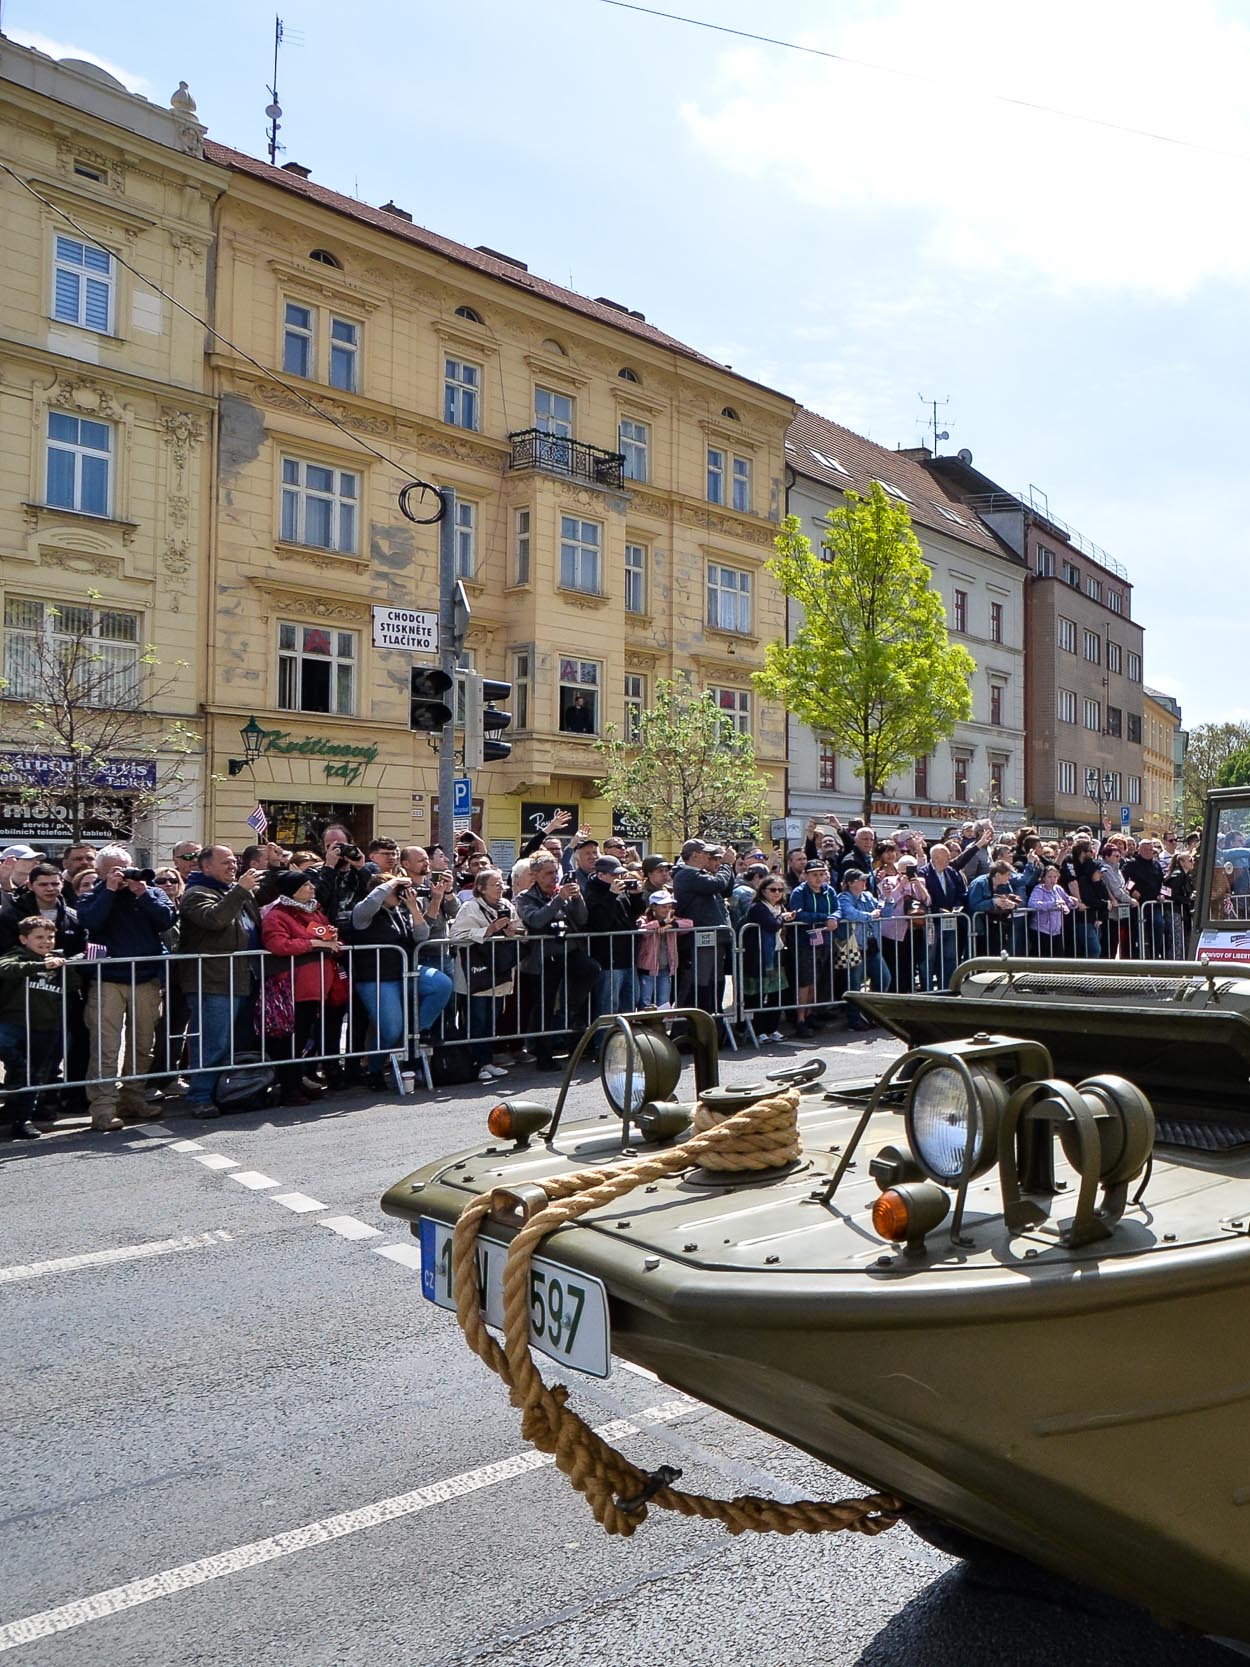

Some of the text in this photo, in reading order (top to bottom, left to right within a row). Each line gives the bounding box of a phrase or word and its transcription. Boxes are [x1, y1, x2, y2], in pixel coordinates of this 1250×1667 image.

[388, 611, 425, 624] CHODCI
[380, 622, 432, 637] STISKNĚTE
[383, 634, 430, 648] TLAČÍTKO
[323, 761, 362, 786] ráj
[455, 783, 467, 806] P
[1122, 808, 1128, 820] P
[424, 1271, 434, 1290] CZ
[529, 1268, 586, 1354] 597
